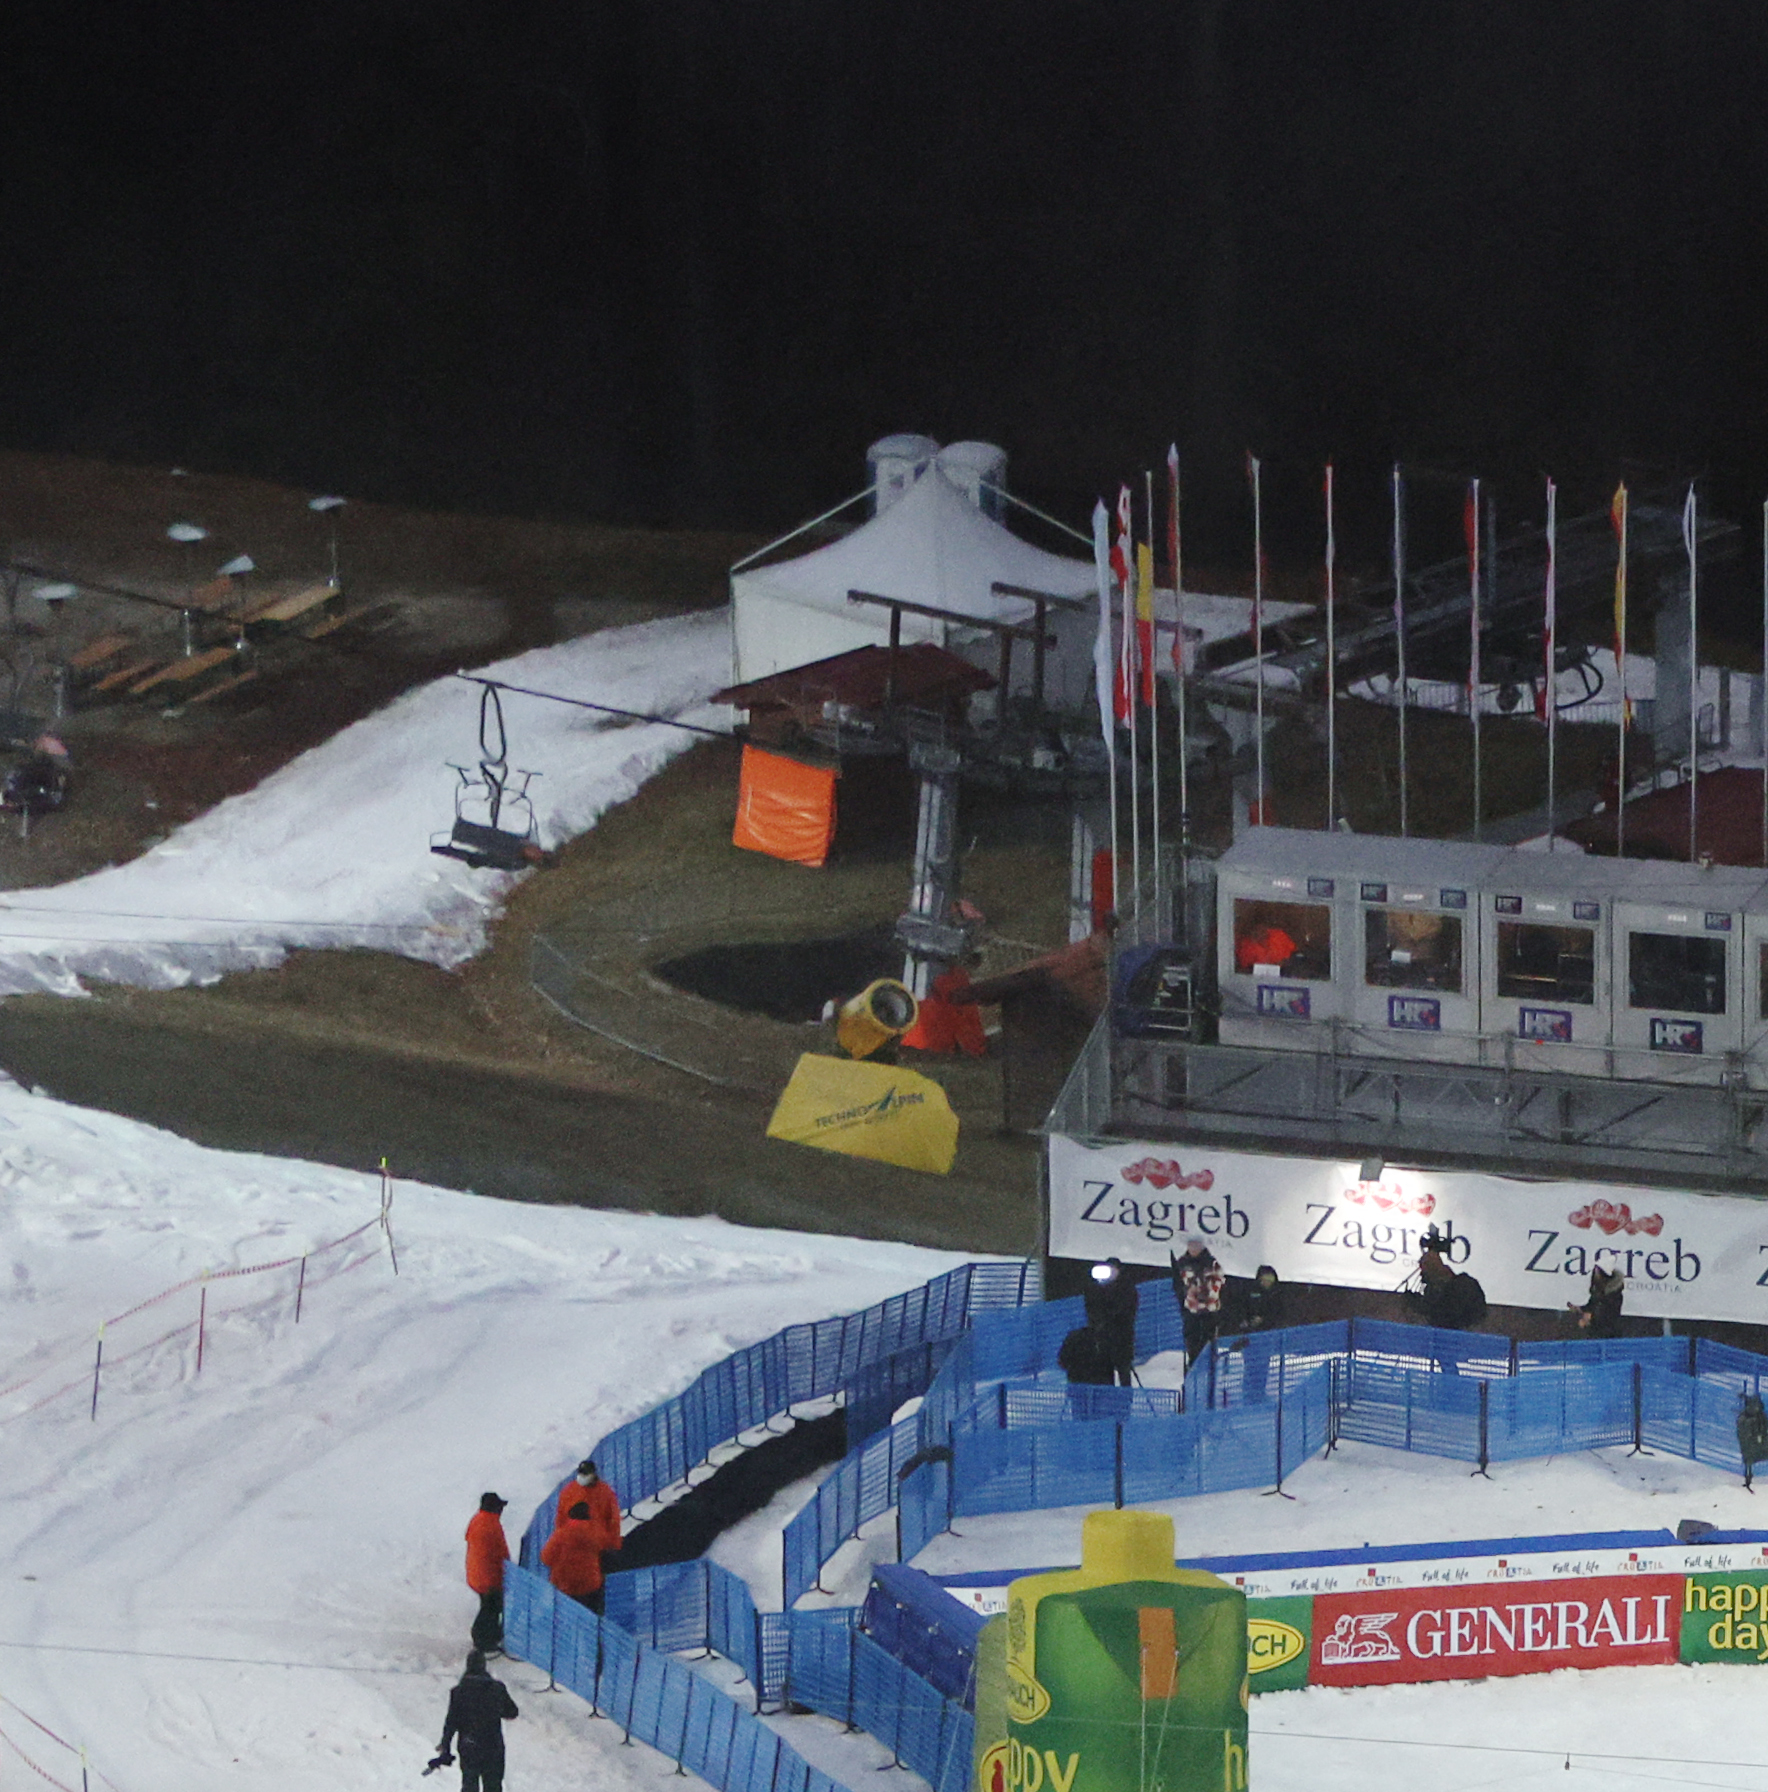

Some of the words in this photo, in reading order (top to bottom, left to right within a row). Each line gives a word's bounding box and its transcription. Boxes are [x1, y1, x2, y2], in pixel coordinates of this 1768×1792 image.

[1080, 1179, 1250, 1242] Zagreb
[1626, 1280, 1683, 1294] CROATIA
[1407, 1594, 1672, 1660] GENERALI
